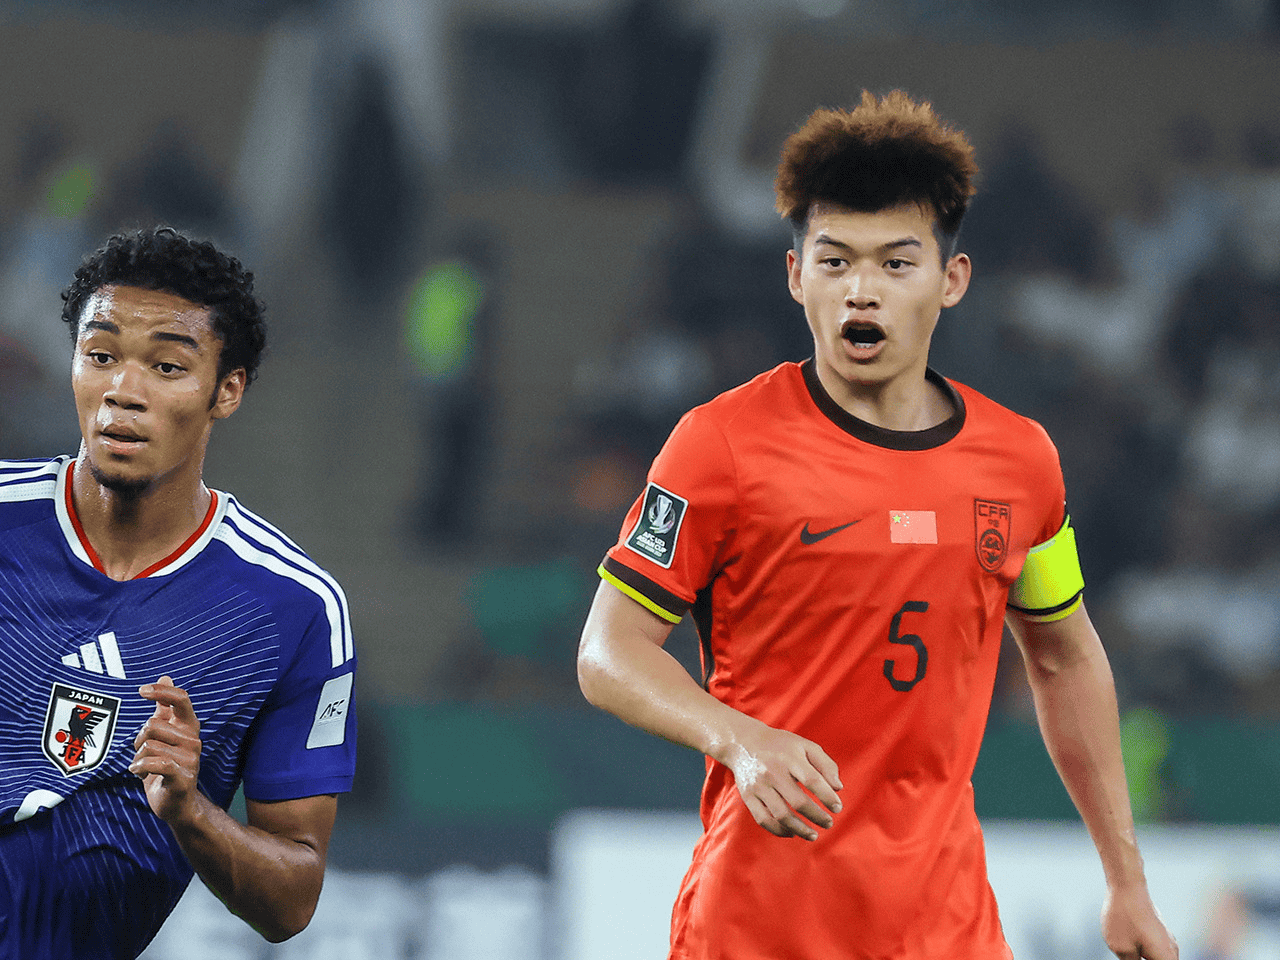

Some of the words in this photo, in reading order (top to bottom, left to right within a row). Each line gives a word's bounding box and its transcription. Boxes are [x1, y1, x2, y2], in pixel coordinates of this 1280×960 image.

[979, 504, 1008, 520] CFA
[883, 600, 929, 692] 5
[68, 691, 104, 705] JAPAN
[319, 699, 346, 719] AFC
[58, 745, 86, 764] JFA
